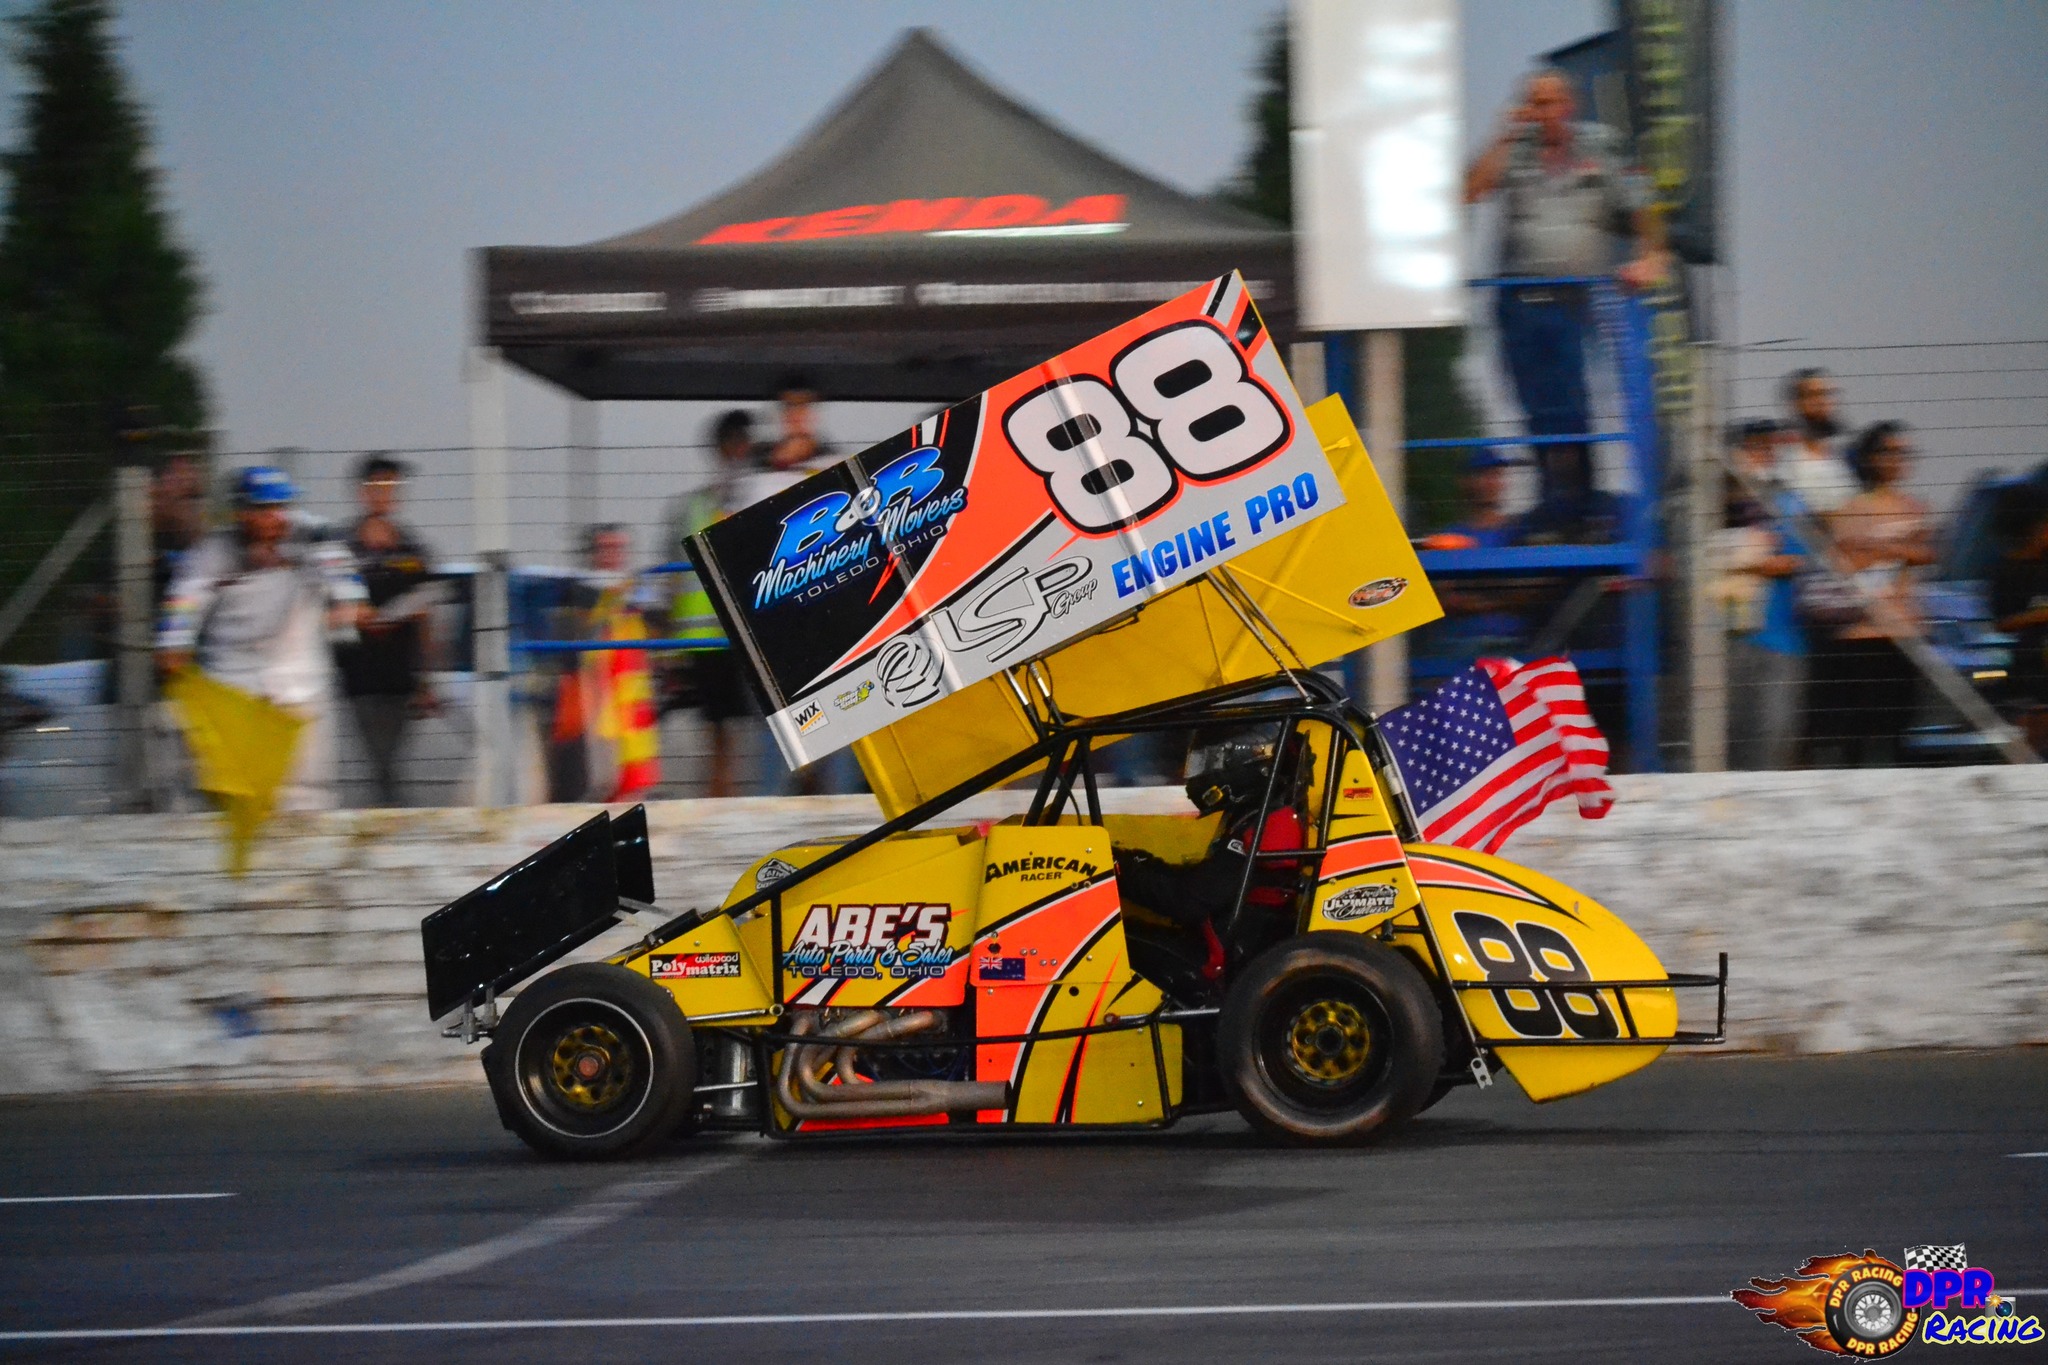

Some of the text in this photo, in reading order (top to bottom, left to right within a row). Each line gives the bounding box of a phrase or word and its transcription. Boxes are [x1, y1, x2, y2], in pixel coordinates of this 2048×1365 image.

[692, 193, 1129, 245] KENDA
[1001, 318, 1291, 536] 88
[753, 488, 965, 609] Machinery Movers
[1111, 472, 1319, 599] ENGINE PRO
[793, 523, 944, 603] TOLEDO OHIO
[1050, 578, 1098, 619] Group
[795, 701, 821, 727] WIX
[984, 856, 1098, 884] AMERICAN
[1020, 871, 1062, 882] RACER
[1323, 896, 1394, 911] ULTIMATE
[792, 904, 951, 948] ABE'S
[783, 940, 825, 966] Auto
[830, 940, 877, 966] Parts
[901, 939, 953, 966] Sales
[891, 965, 945, 977] OHIO
[1452, 910, 1621, 1041] 88
